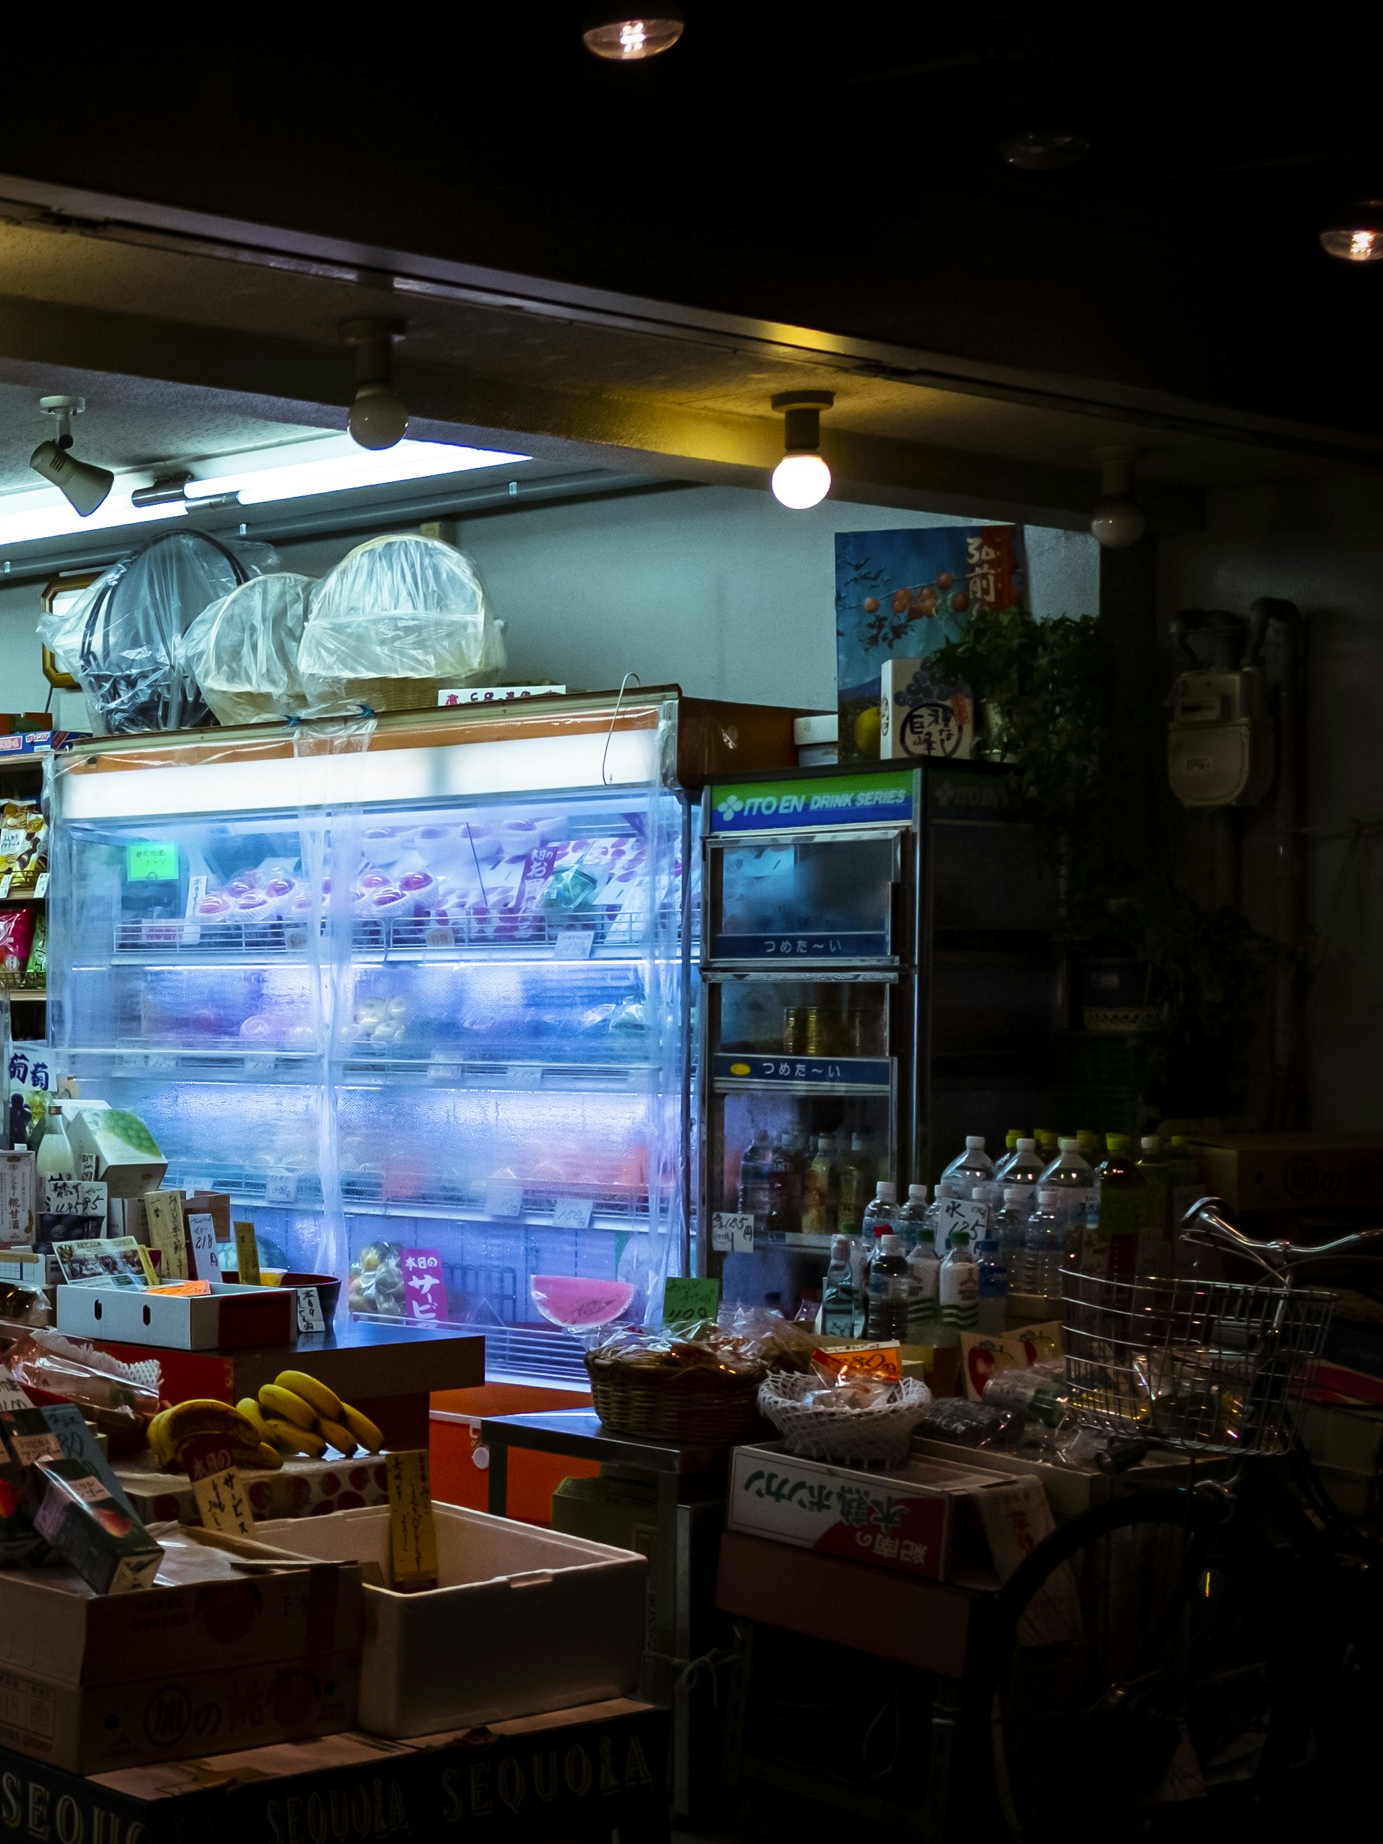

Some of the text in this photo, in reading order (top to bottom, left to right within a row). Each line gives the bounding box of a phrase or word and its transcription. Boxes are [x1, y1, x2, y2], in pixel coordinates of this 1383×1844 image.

[744, 789, 906, 816] ITO EN DRINK SERIES
[404, 1256, 438, 1271] 本日の
[223, 1473, 250, 1535] サービス
